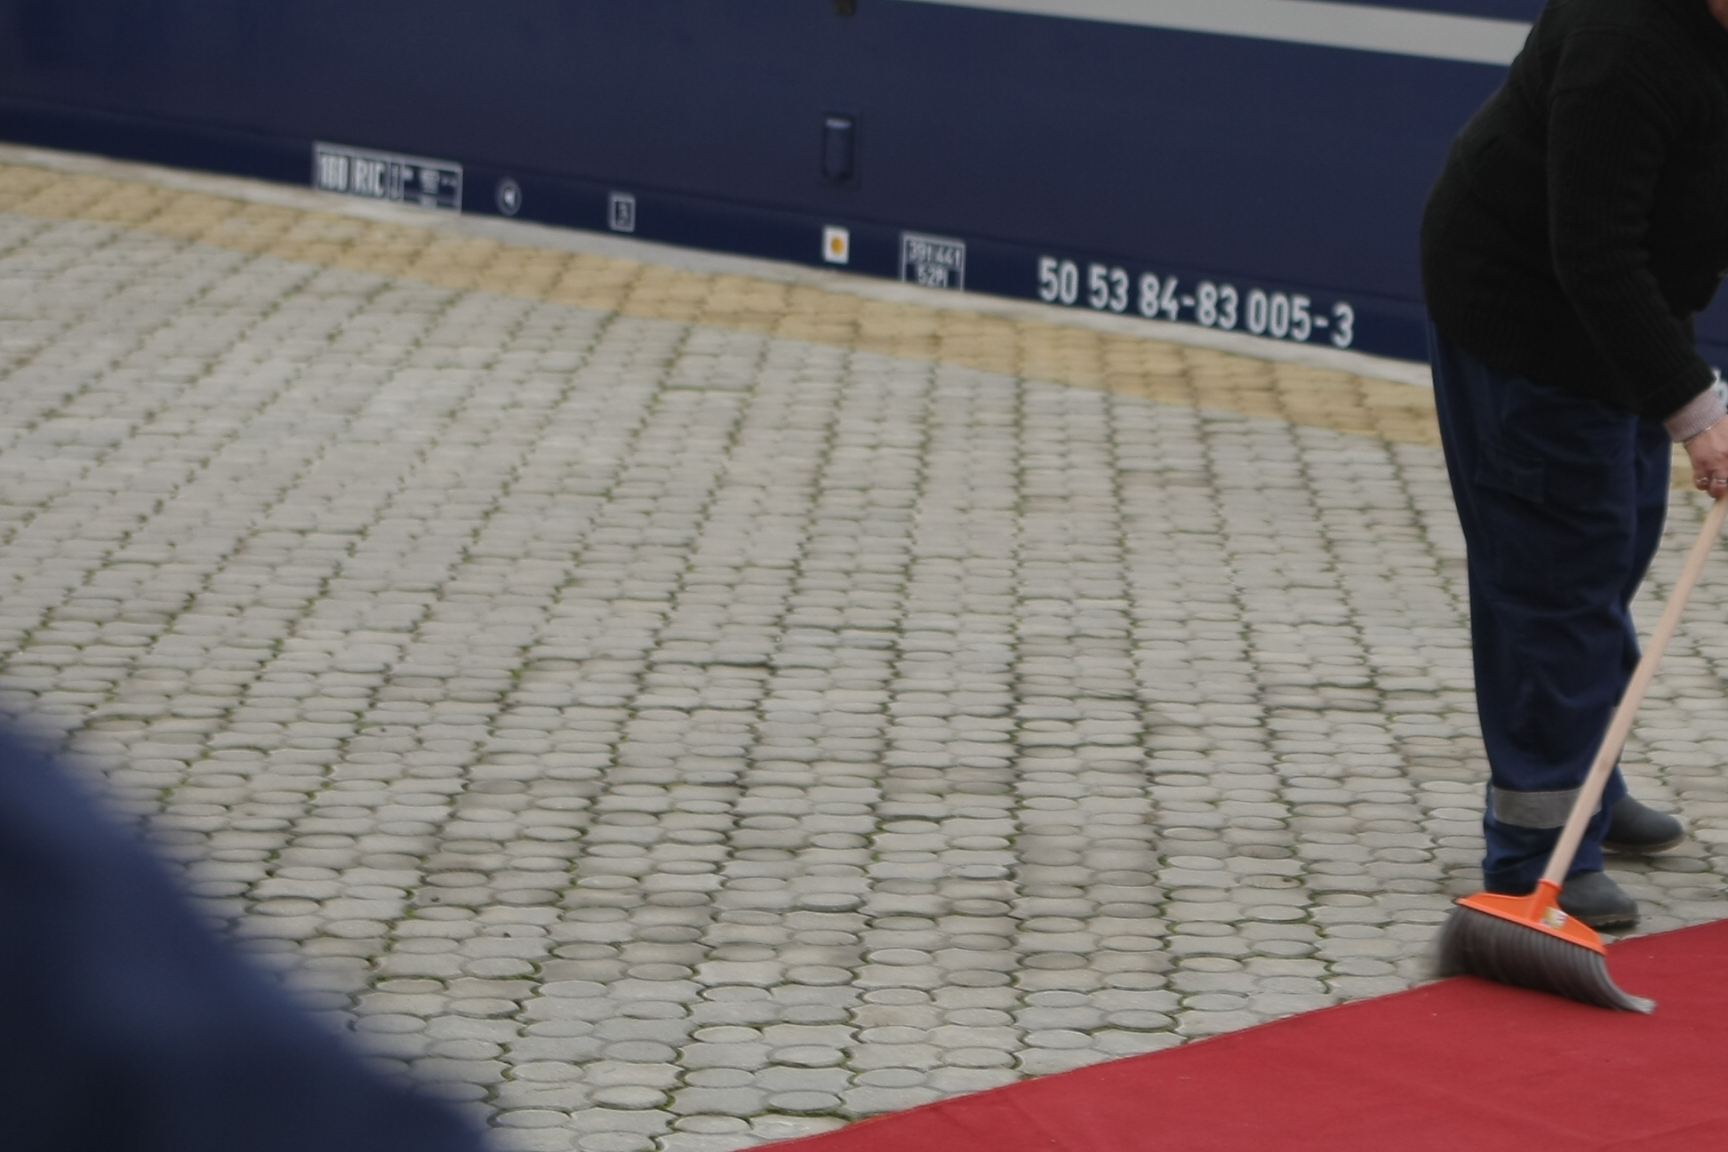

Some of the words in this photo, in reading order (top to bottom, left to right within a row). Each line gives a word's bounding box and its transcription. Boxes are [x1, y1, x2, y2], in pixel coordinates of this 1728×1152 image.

[1038, 257, 1079, 305] 50
[1088, 263, 1128, 312] 53
[1138, 273, 1238, 330] 84-83
[1246, 289, 1354, 349] 005-3
